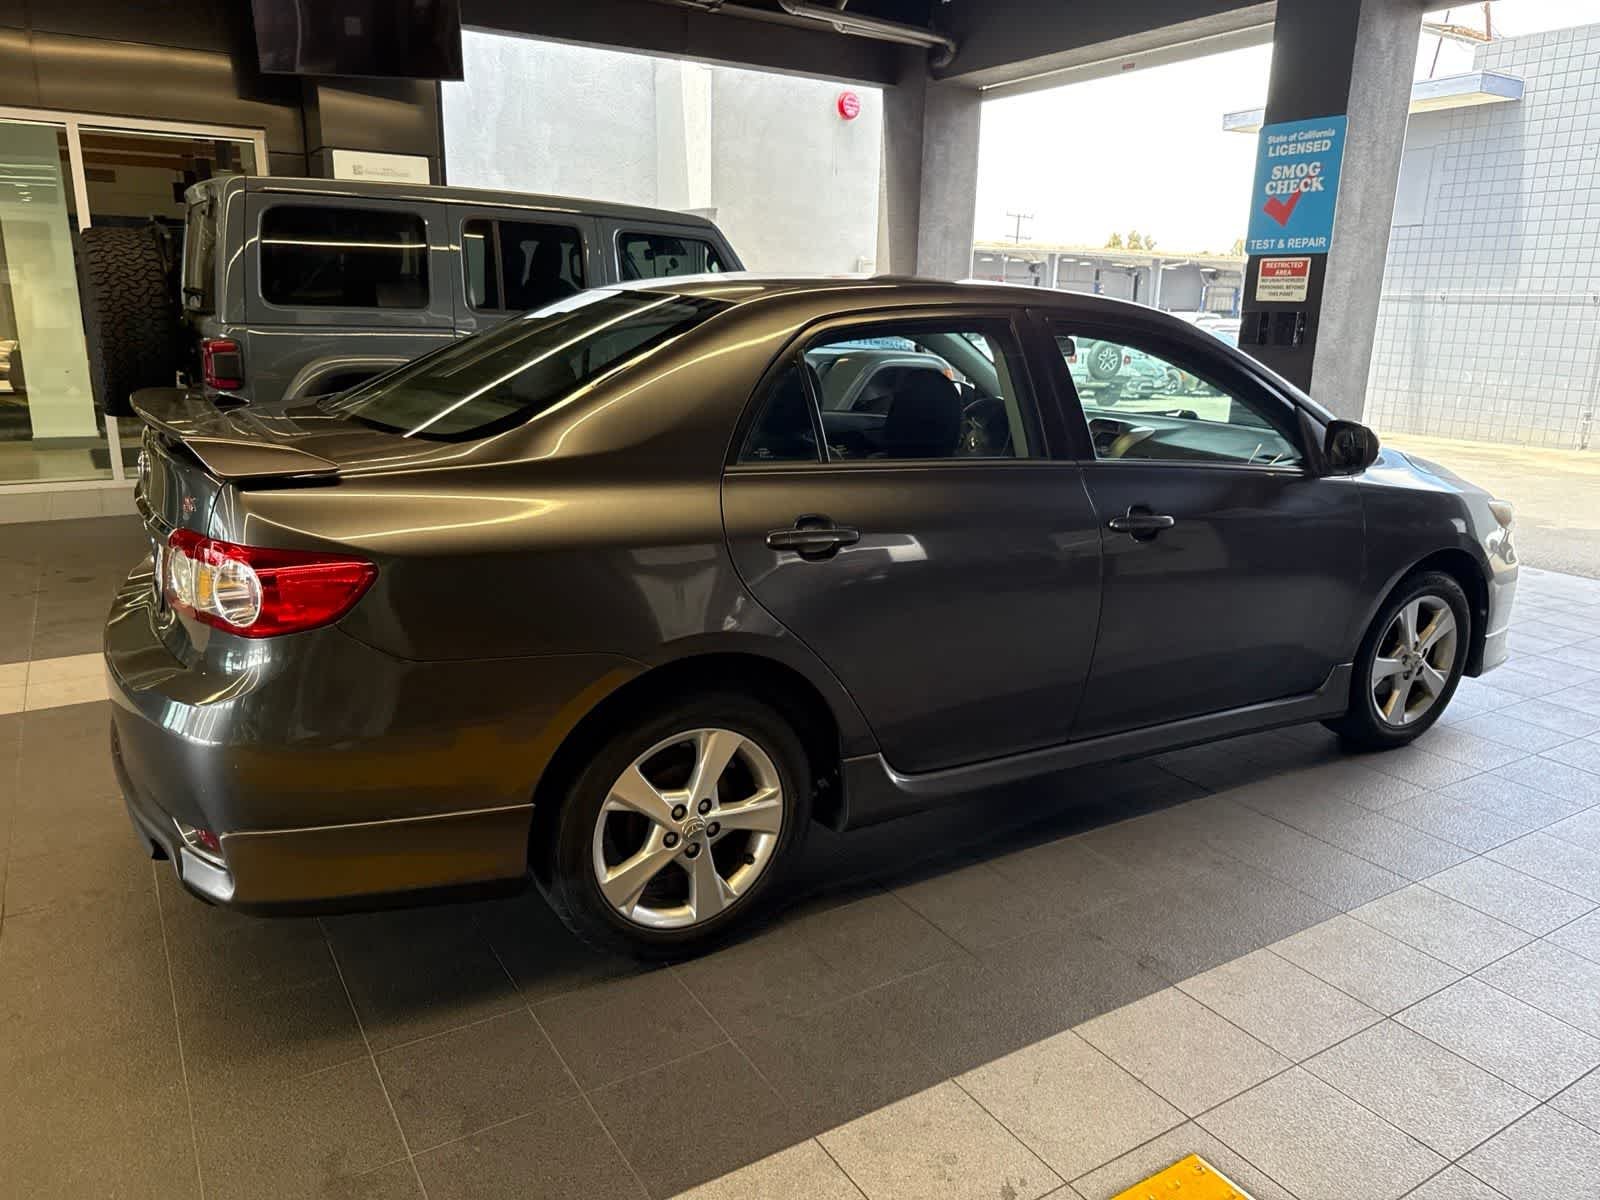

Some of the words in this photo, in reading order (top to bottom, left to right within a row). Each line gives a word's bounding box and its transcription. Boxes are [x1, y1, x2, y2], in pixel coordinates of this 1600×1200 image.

[1267, 135, 1287, 144] State
[1288, 132, 1298, 142] of
[1298, 128, 1335, 141] California
[1268, 139, 1332, 157] LICENSED
[1271, 161, 1321, 180] SMOG
[1264, 176, 1325, 195] CHECK
[1250, 239, 1275, 250] TEST
[1277, 238, 1285, 249] &
[1287, 236, 1327, 249] REPAIR
[1264, 261, 1304, 269] RESTRICTED
